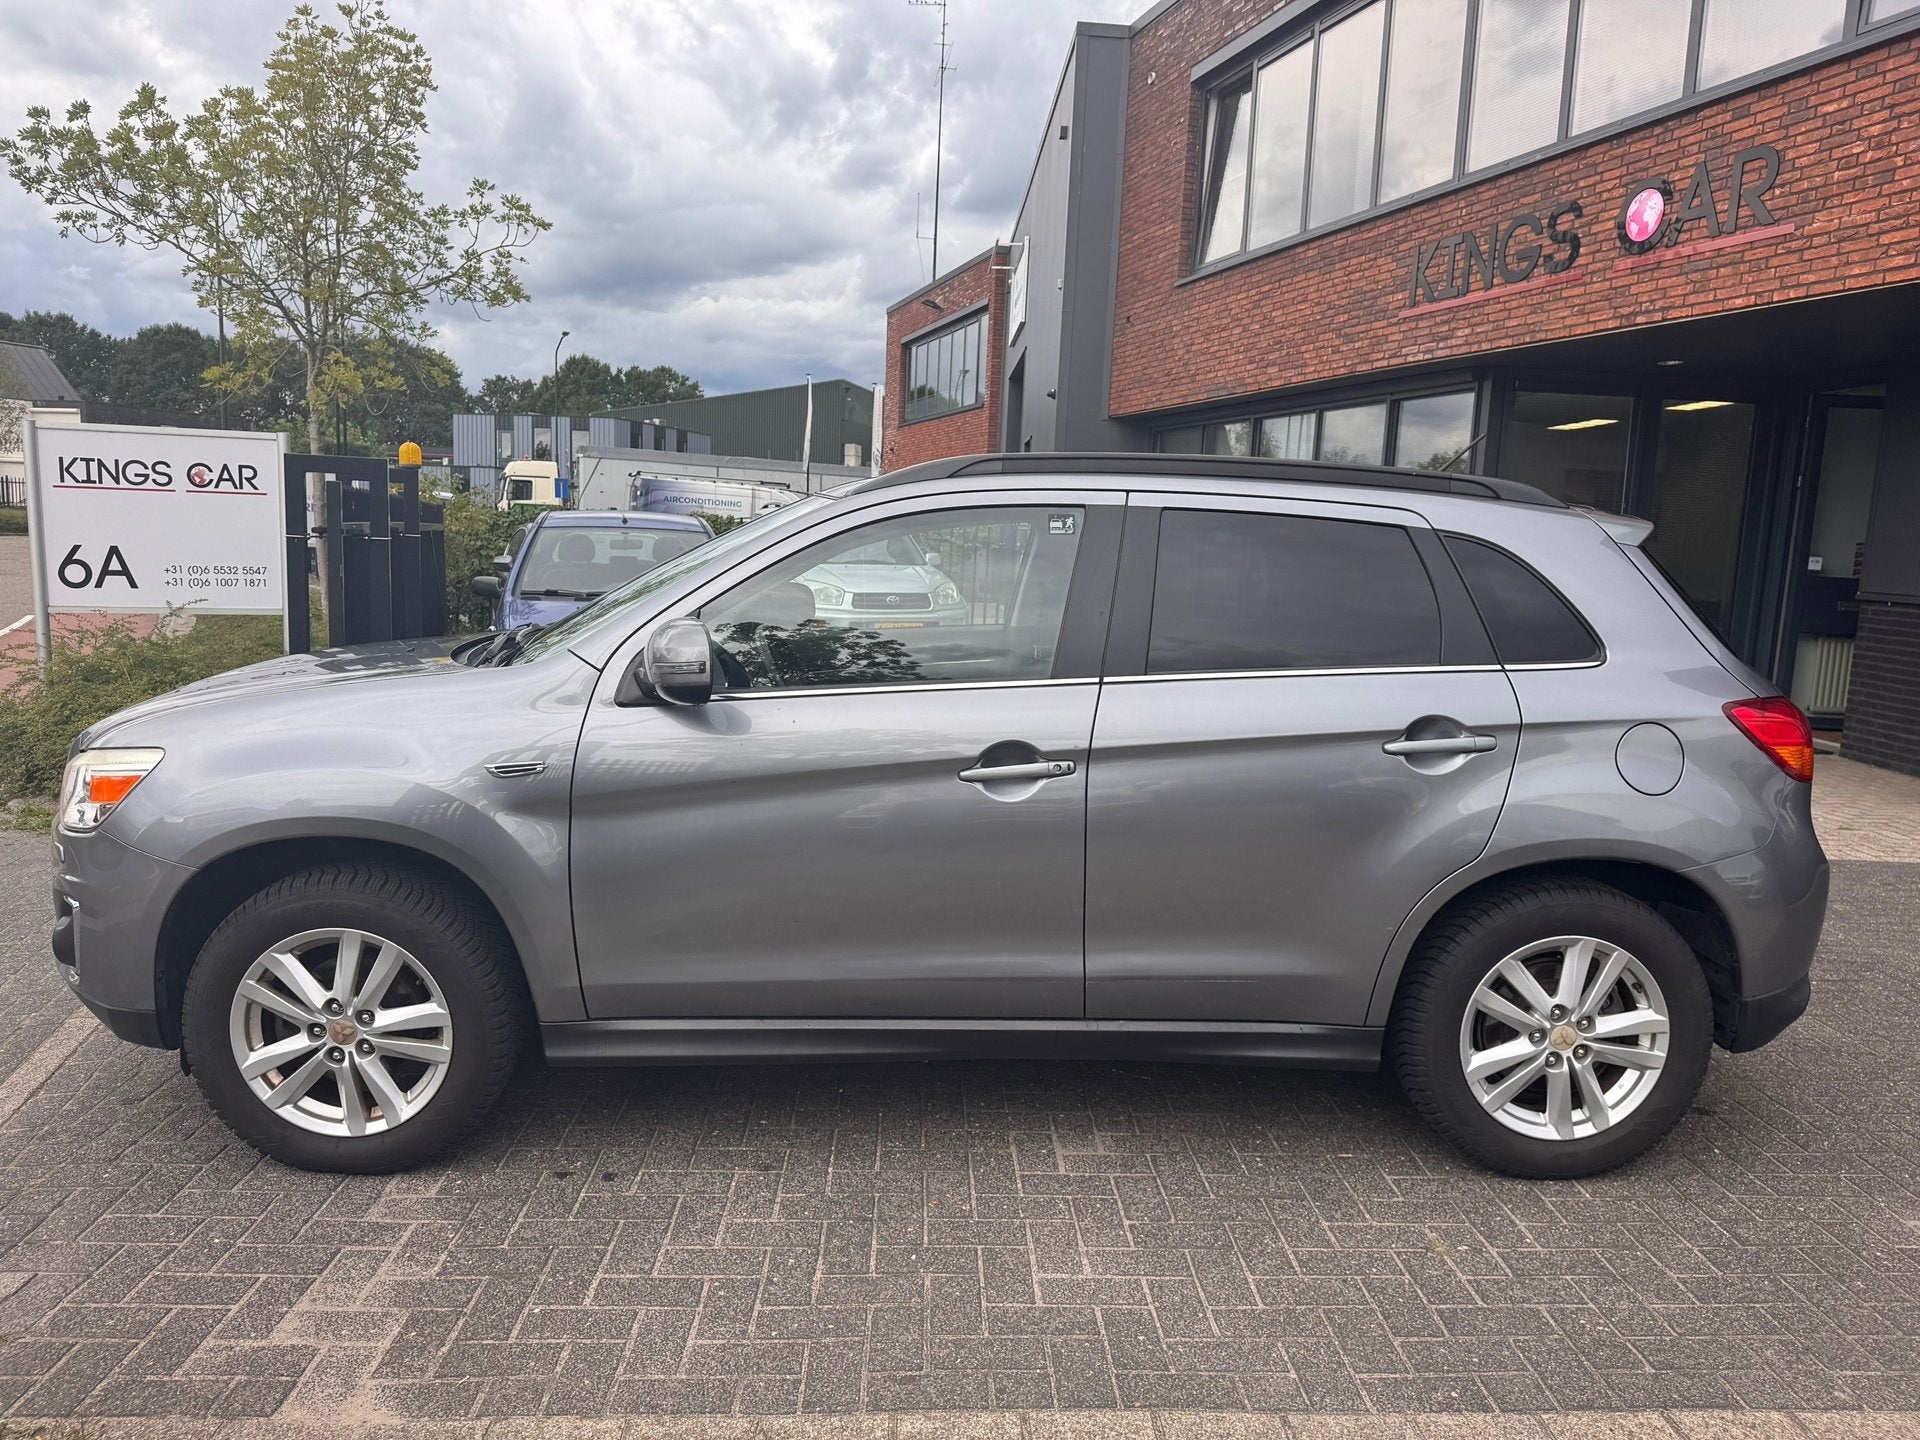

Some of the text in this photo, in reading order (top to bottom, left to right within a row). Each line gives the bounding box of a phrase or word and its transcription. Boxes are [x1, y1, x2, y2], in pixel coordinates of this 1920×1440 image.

[1409, 143, 1781, 307] KINGS CAR
[58, 456, 260, 490] KINGS CAR
[663, 495, 742, 508] AIRCONDITIONING
[57, 544, 139, 589] 6A
[163, 564, 268, 577] +31 (0)6 5532 5547
[164, 577, 267, 589] +31 (0)6 1007 1871
